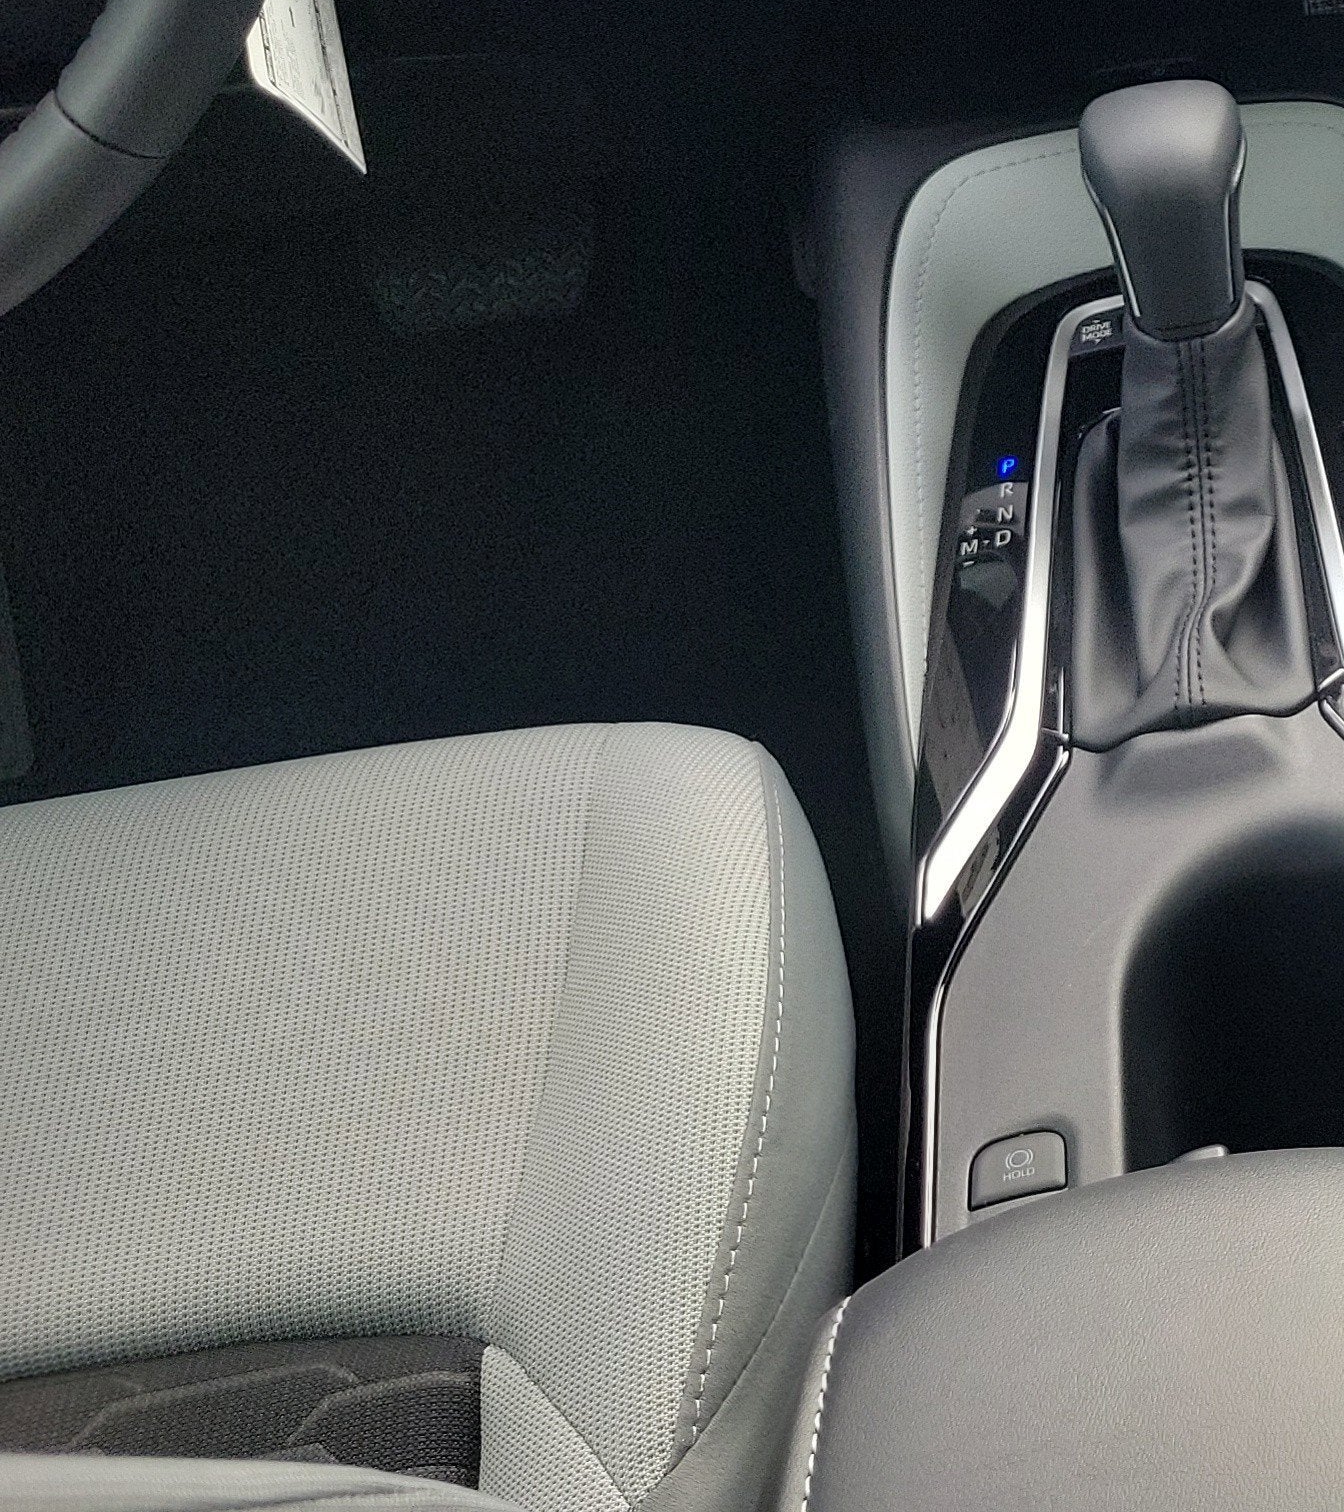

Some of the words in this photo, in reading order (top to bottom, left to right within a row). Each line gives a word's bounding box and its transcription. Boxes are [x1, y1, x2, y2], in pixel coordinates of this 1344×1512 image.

[1082, 321, 1111, 334] DRIVE
[1082, 328, 1112, 342] MODE
[1002, 458, 1015, 473] P
[1000, 482, 1014, 498] R
[997, 504, 1013, 522] N
[961, 539, 979, 555] M
[996, 529, 1011, 547] D
[1003, 1167, 1035, 1181] HOLD
